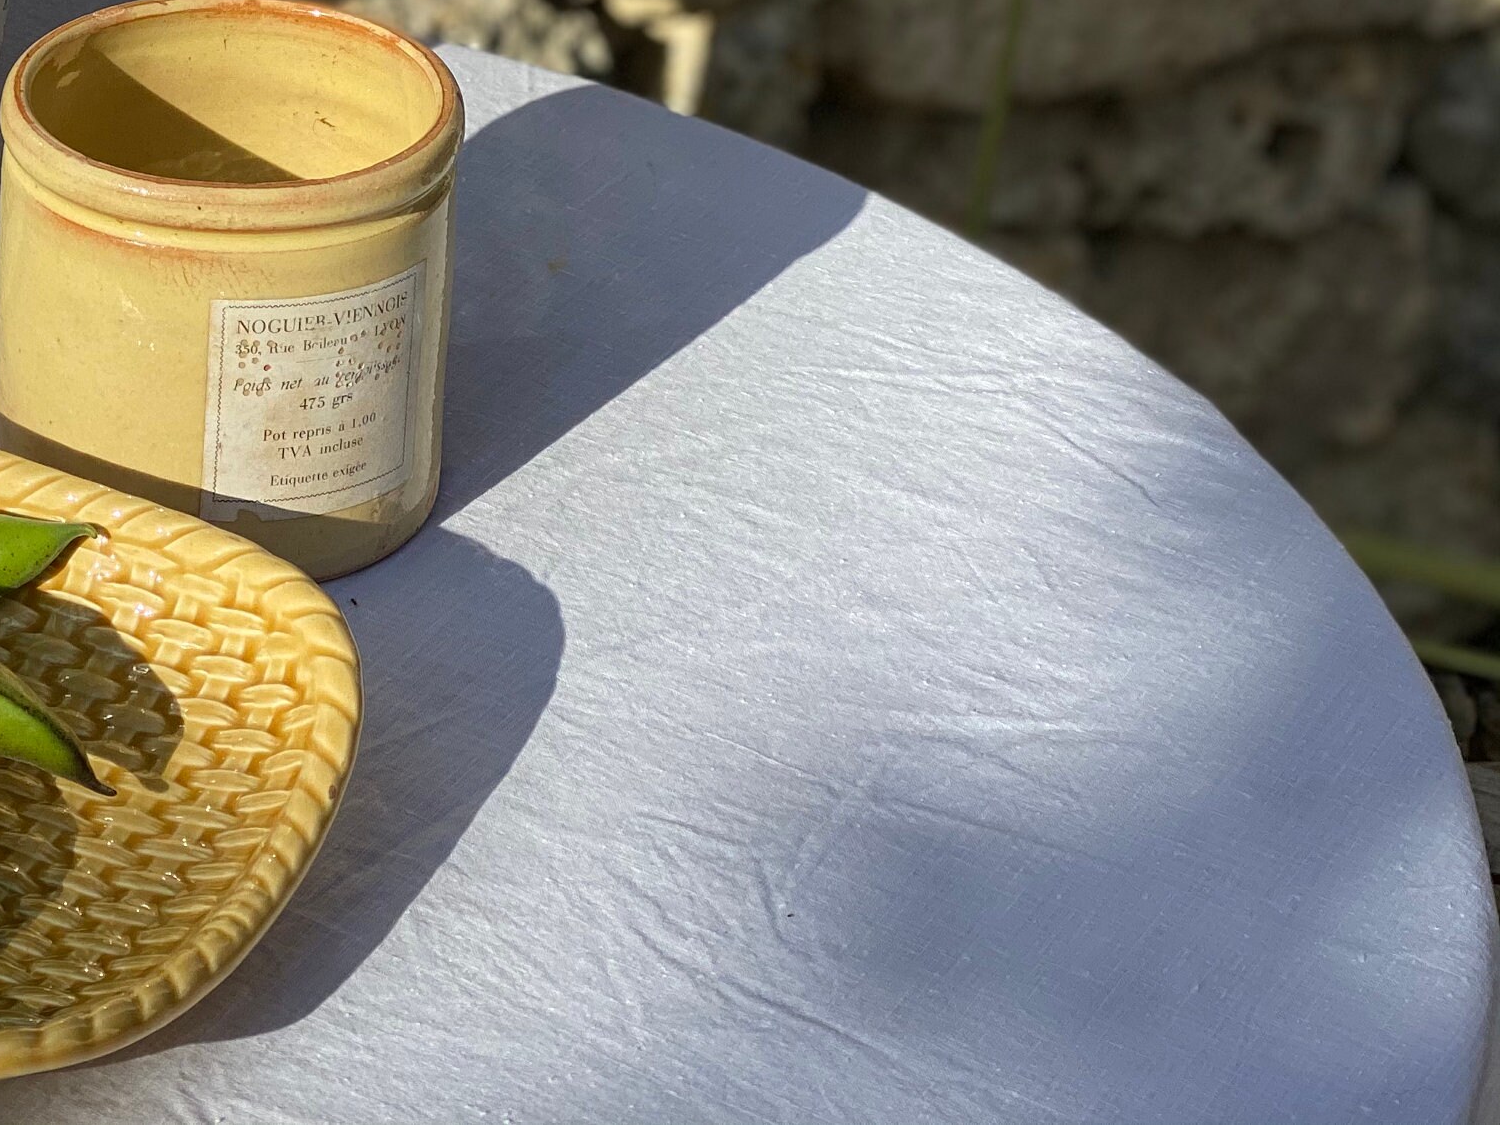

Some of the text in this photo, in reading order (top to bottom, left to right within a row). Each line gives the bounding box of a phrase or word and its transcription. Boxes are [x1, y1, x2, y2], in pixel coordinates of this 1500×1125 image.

[281, 377, 303, 390] net
[314, 376, 330, 387] au
[300, 393, 353, 410] 475 grs
[263, 429, 286, 442] Pot
[293, 426, 332, 440] repris
[278, 437, 364, 459] TVA incluse
[332, 462, 367, 478] exigée
